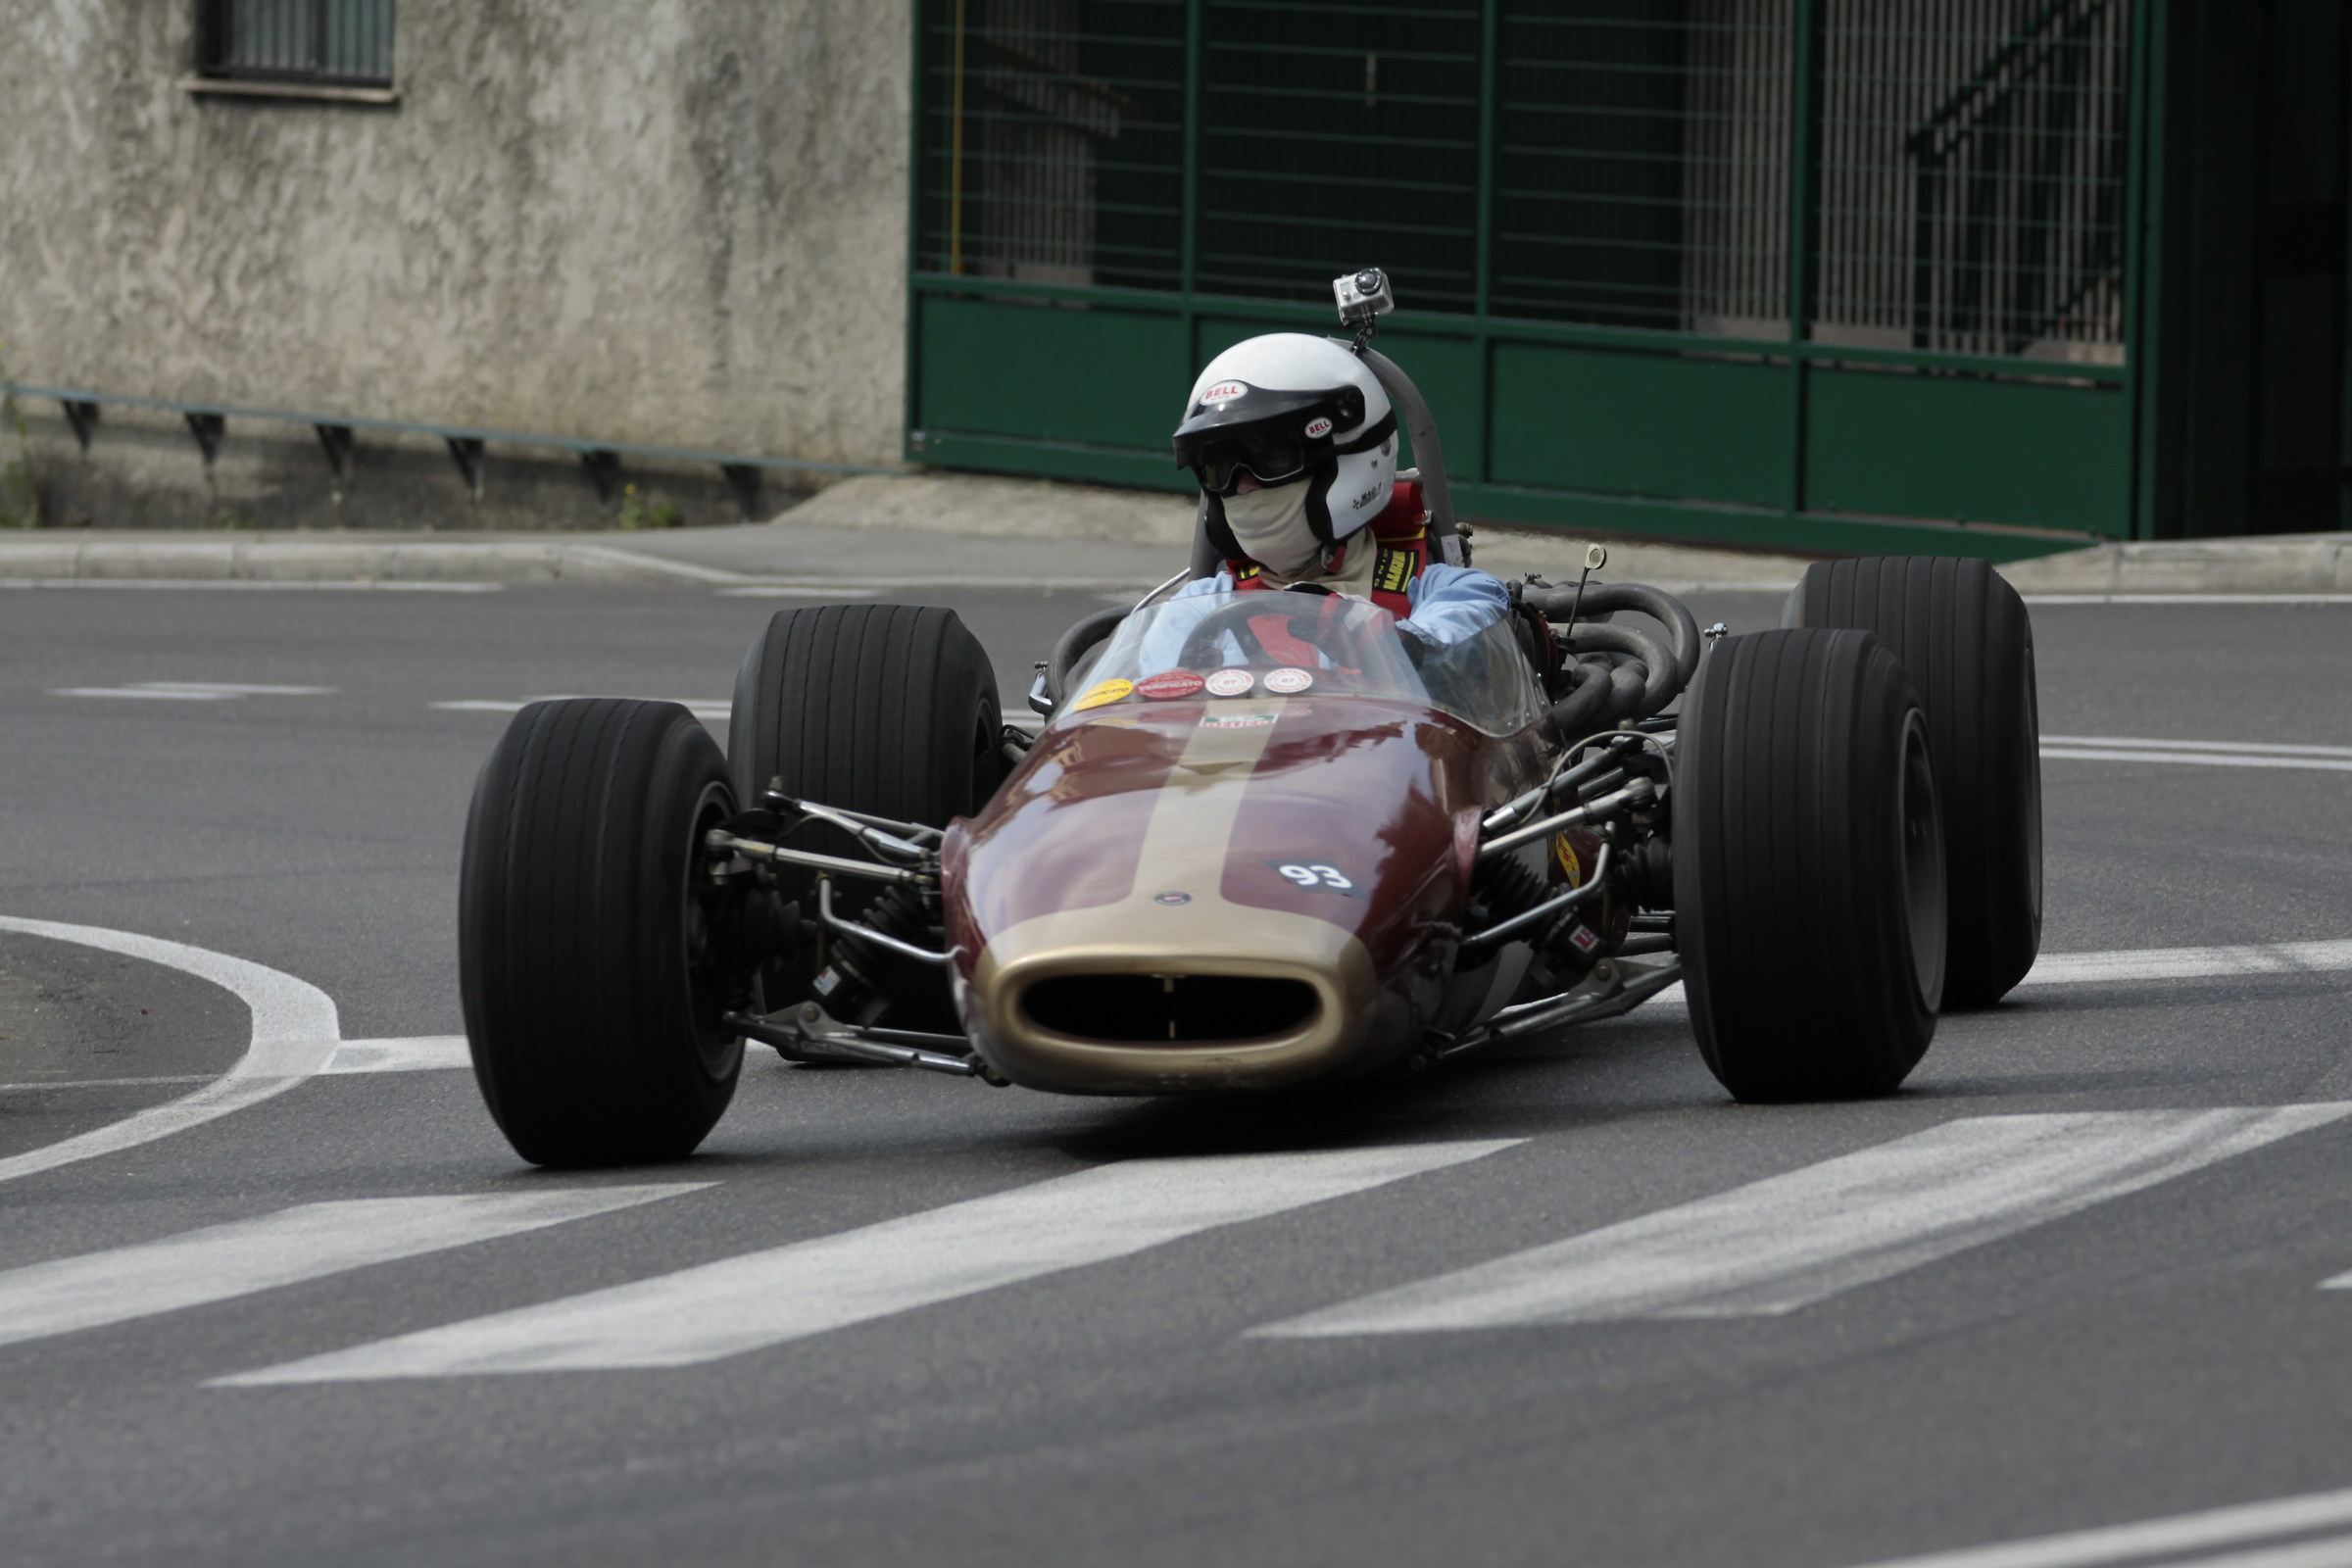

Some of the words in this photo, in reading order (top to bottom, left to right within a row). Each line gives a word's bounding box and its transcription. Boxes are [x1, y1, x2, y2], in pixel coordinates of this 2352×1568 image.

[1204, 385, 1239, 400] BELL
[1308, 419, 1331, 434] BELL
[1278, 864, 1352, 889] 93
